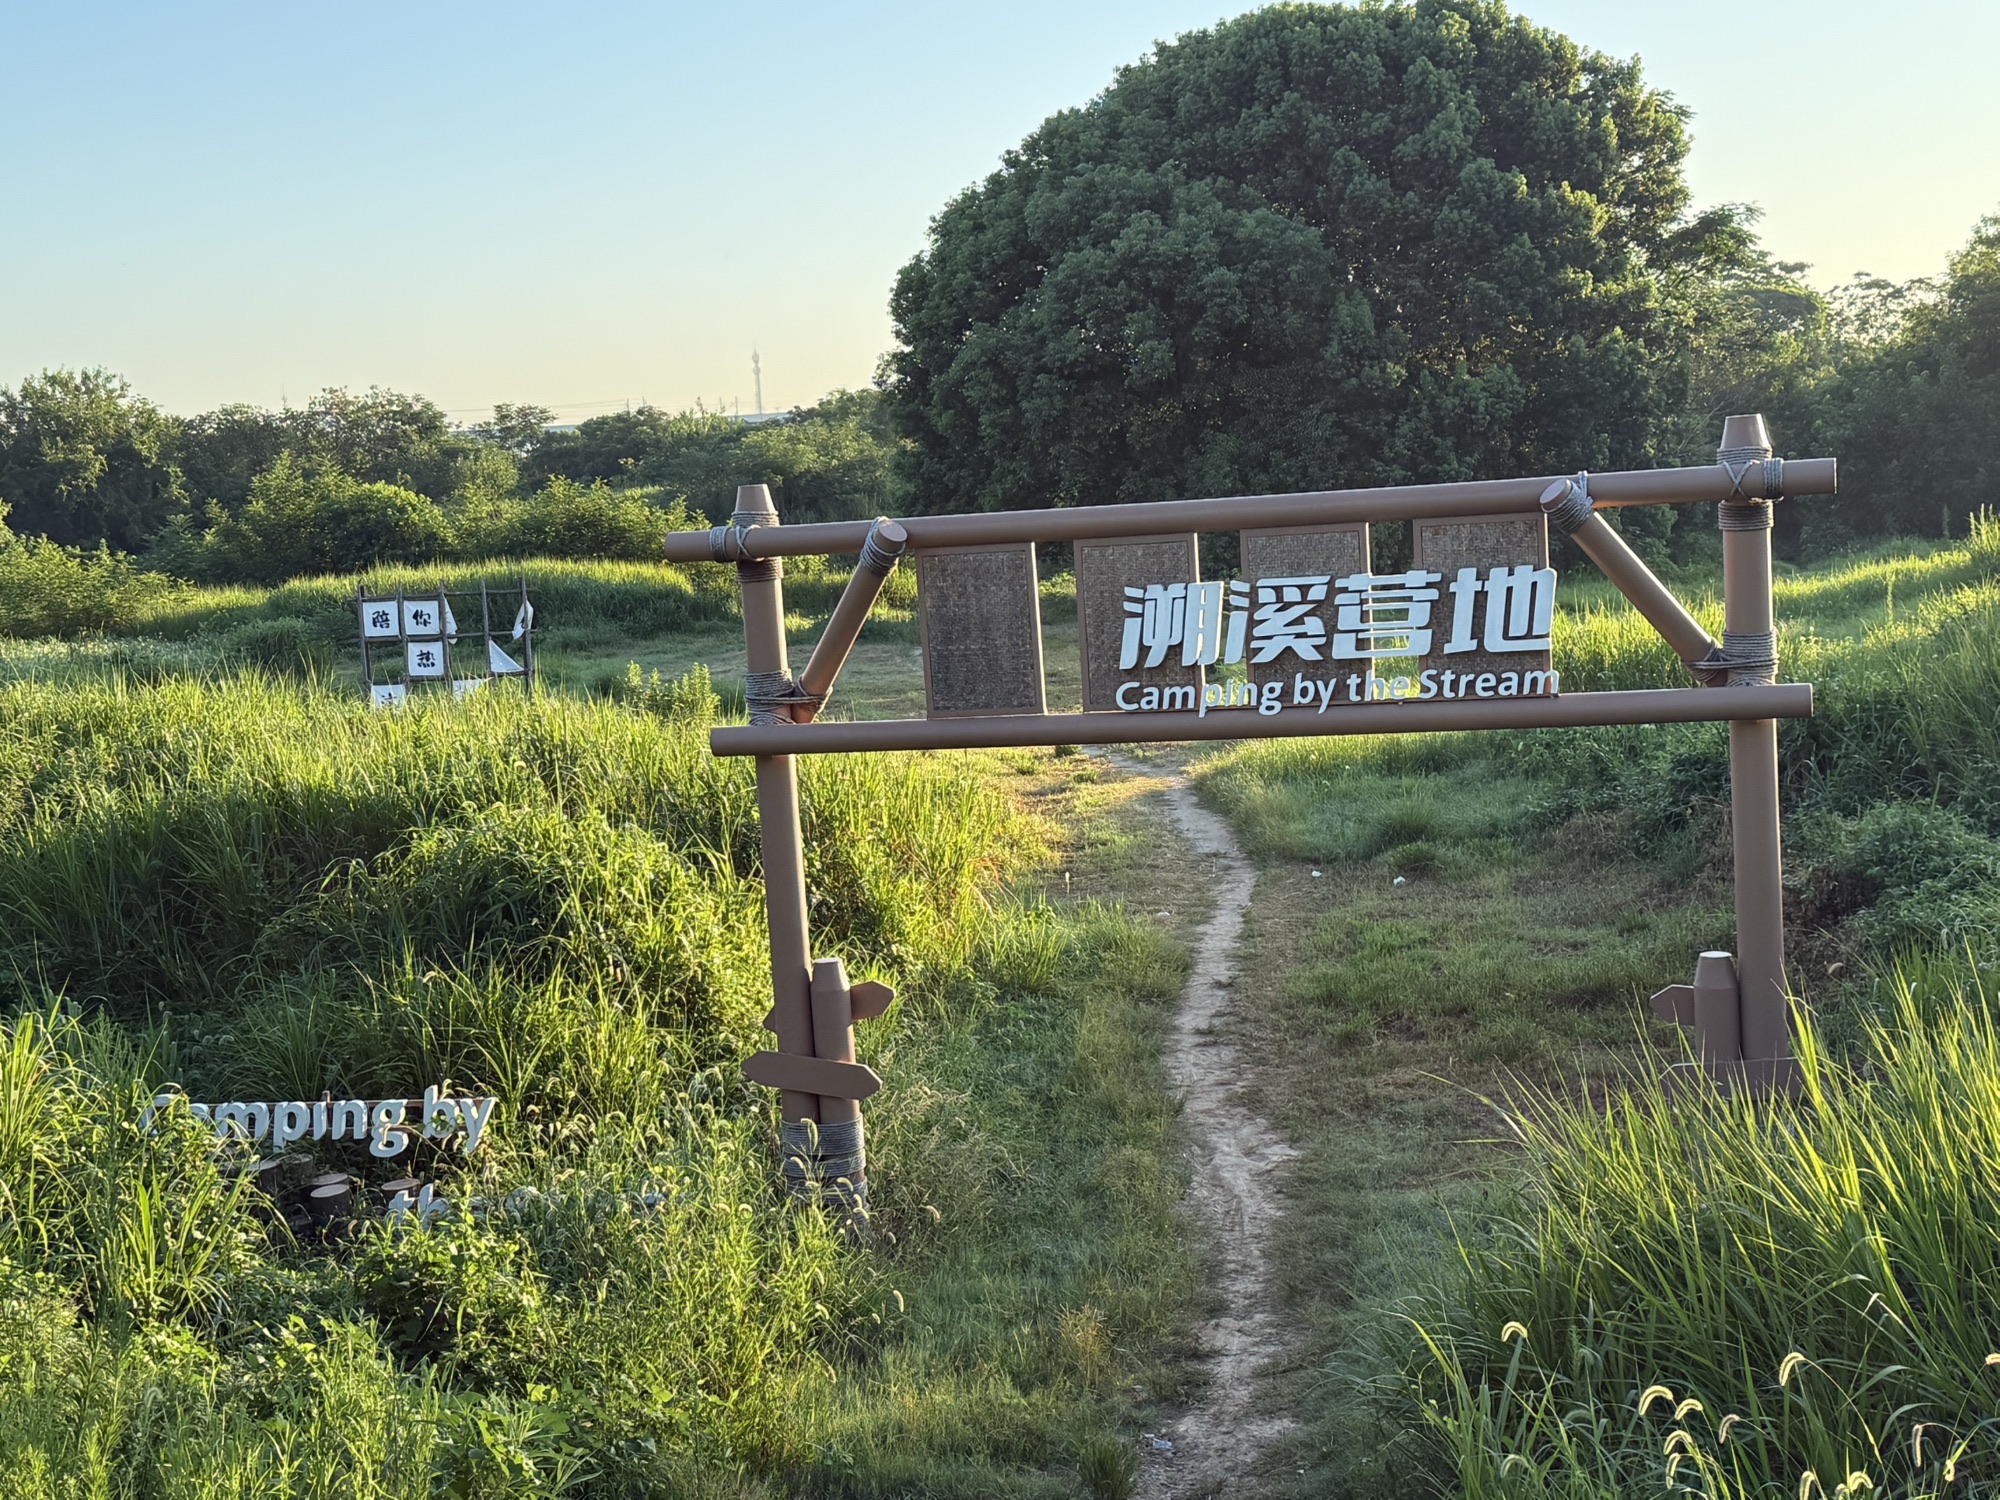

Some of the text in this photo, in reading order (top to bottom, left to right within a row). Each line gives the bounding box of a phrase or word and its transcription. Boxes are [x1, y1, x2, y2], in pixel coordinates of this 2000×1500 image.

[416, 649, 436, 668] 热
[1115, 668, 1560, 716] Camping by the Stream
[422, 1084, 496, 1154] by
